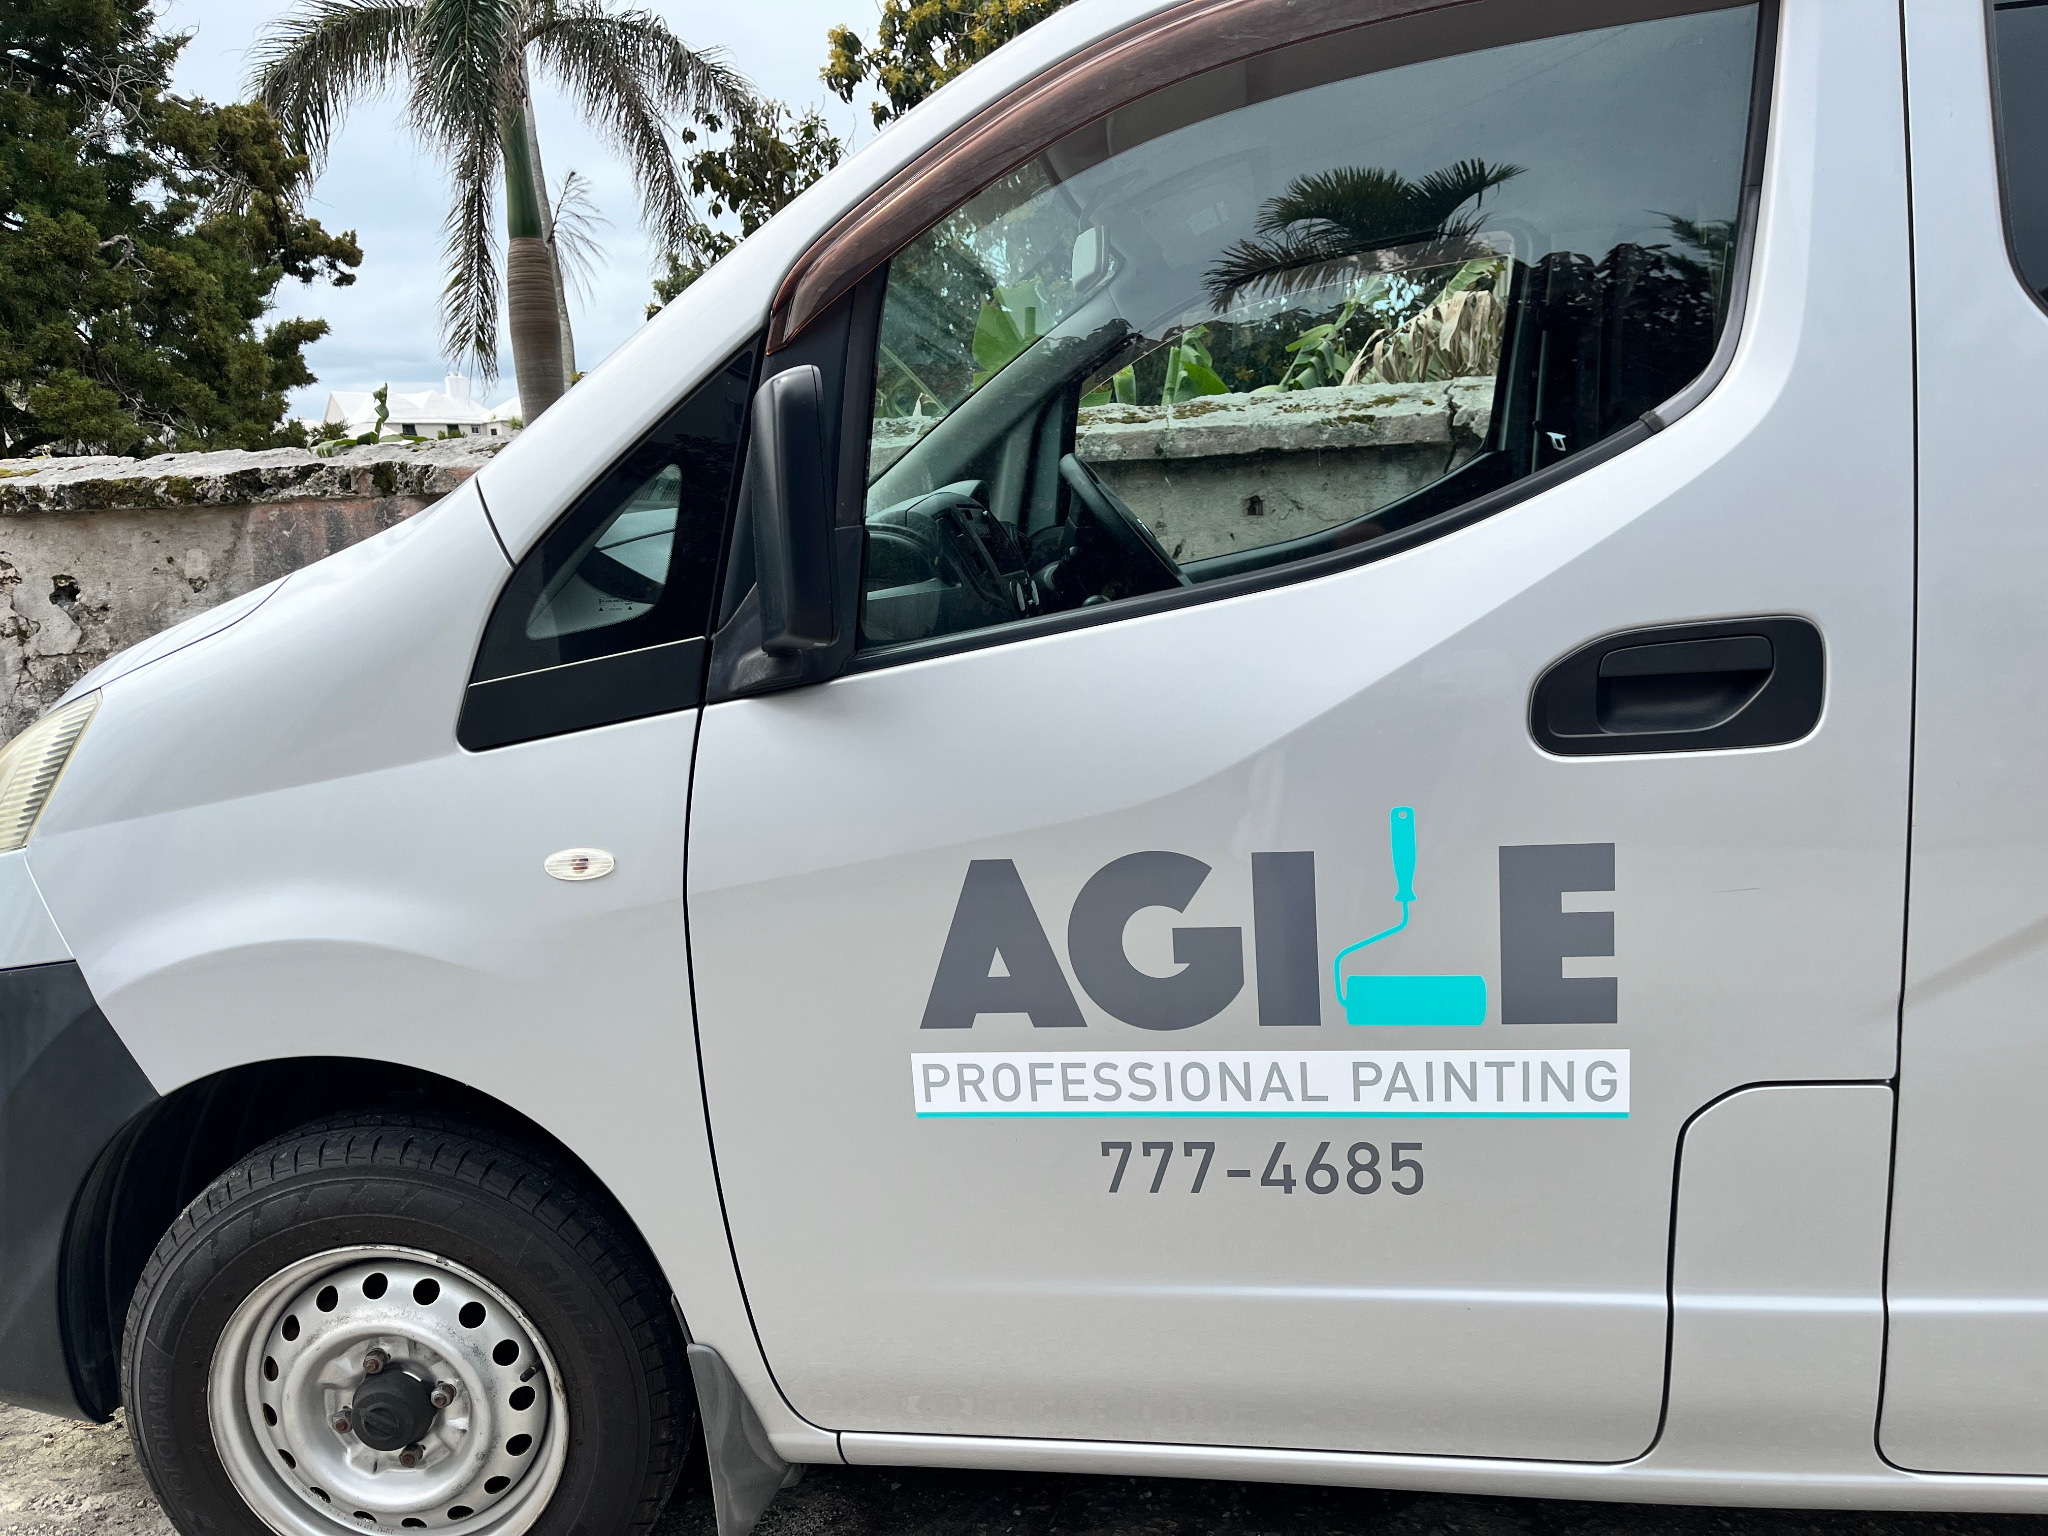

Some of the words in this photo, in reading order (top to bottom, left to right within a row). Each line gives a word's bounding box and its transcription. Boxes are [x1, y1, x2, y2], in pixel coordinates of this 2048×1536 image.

[922, 1061, 1330, 1103] PROFESSIONAL
[1351, 1060, 1619, 1102] PAINTING
[1101, 1141, 1425, 1196] 777-4685
[149, 1367, 195, 1503] YOKOHAMA
